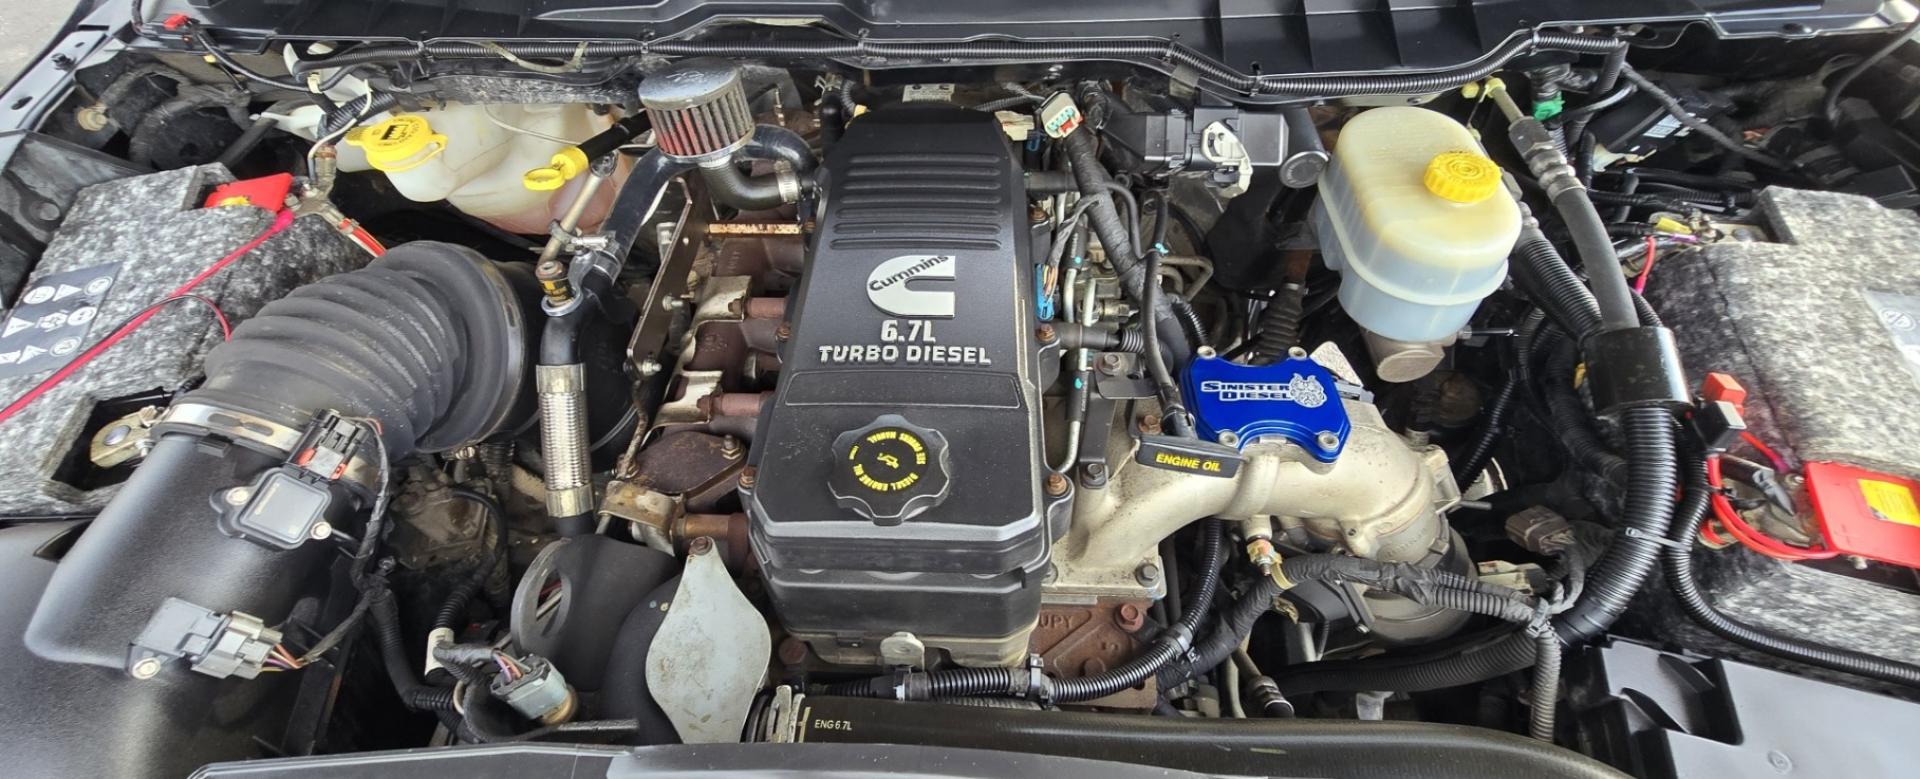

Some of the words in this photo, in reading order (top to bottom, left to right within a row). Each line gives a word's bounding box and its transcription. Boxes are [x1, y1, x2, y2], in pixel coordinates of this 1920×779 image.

[869, 256, 949, 291] Cummins
[881, 320, 937, 342] 6.7L
[818, 345, 899, 363] TURBO
[906, 345, 991, 365] DIESEL
[1156, 453, 1200, 469] ENGINE
[1202, 460, 1221, 473] OIL
[859, 474, 889, 491] ENGINE
[890, 472, 919, 490] DIESEL
[814, 719, 834, 729] ENG
